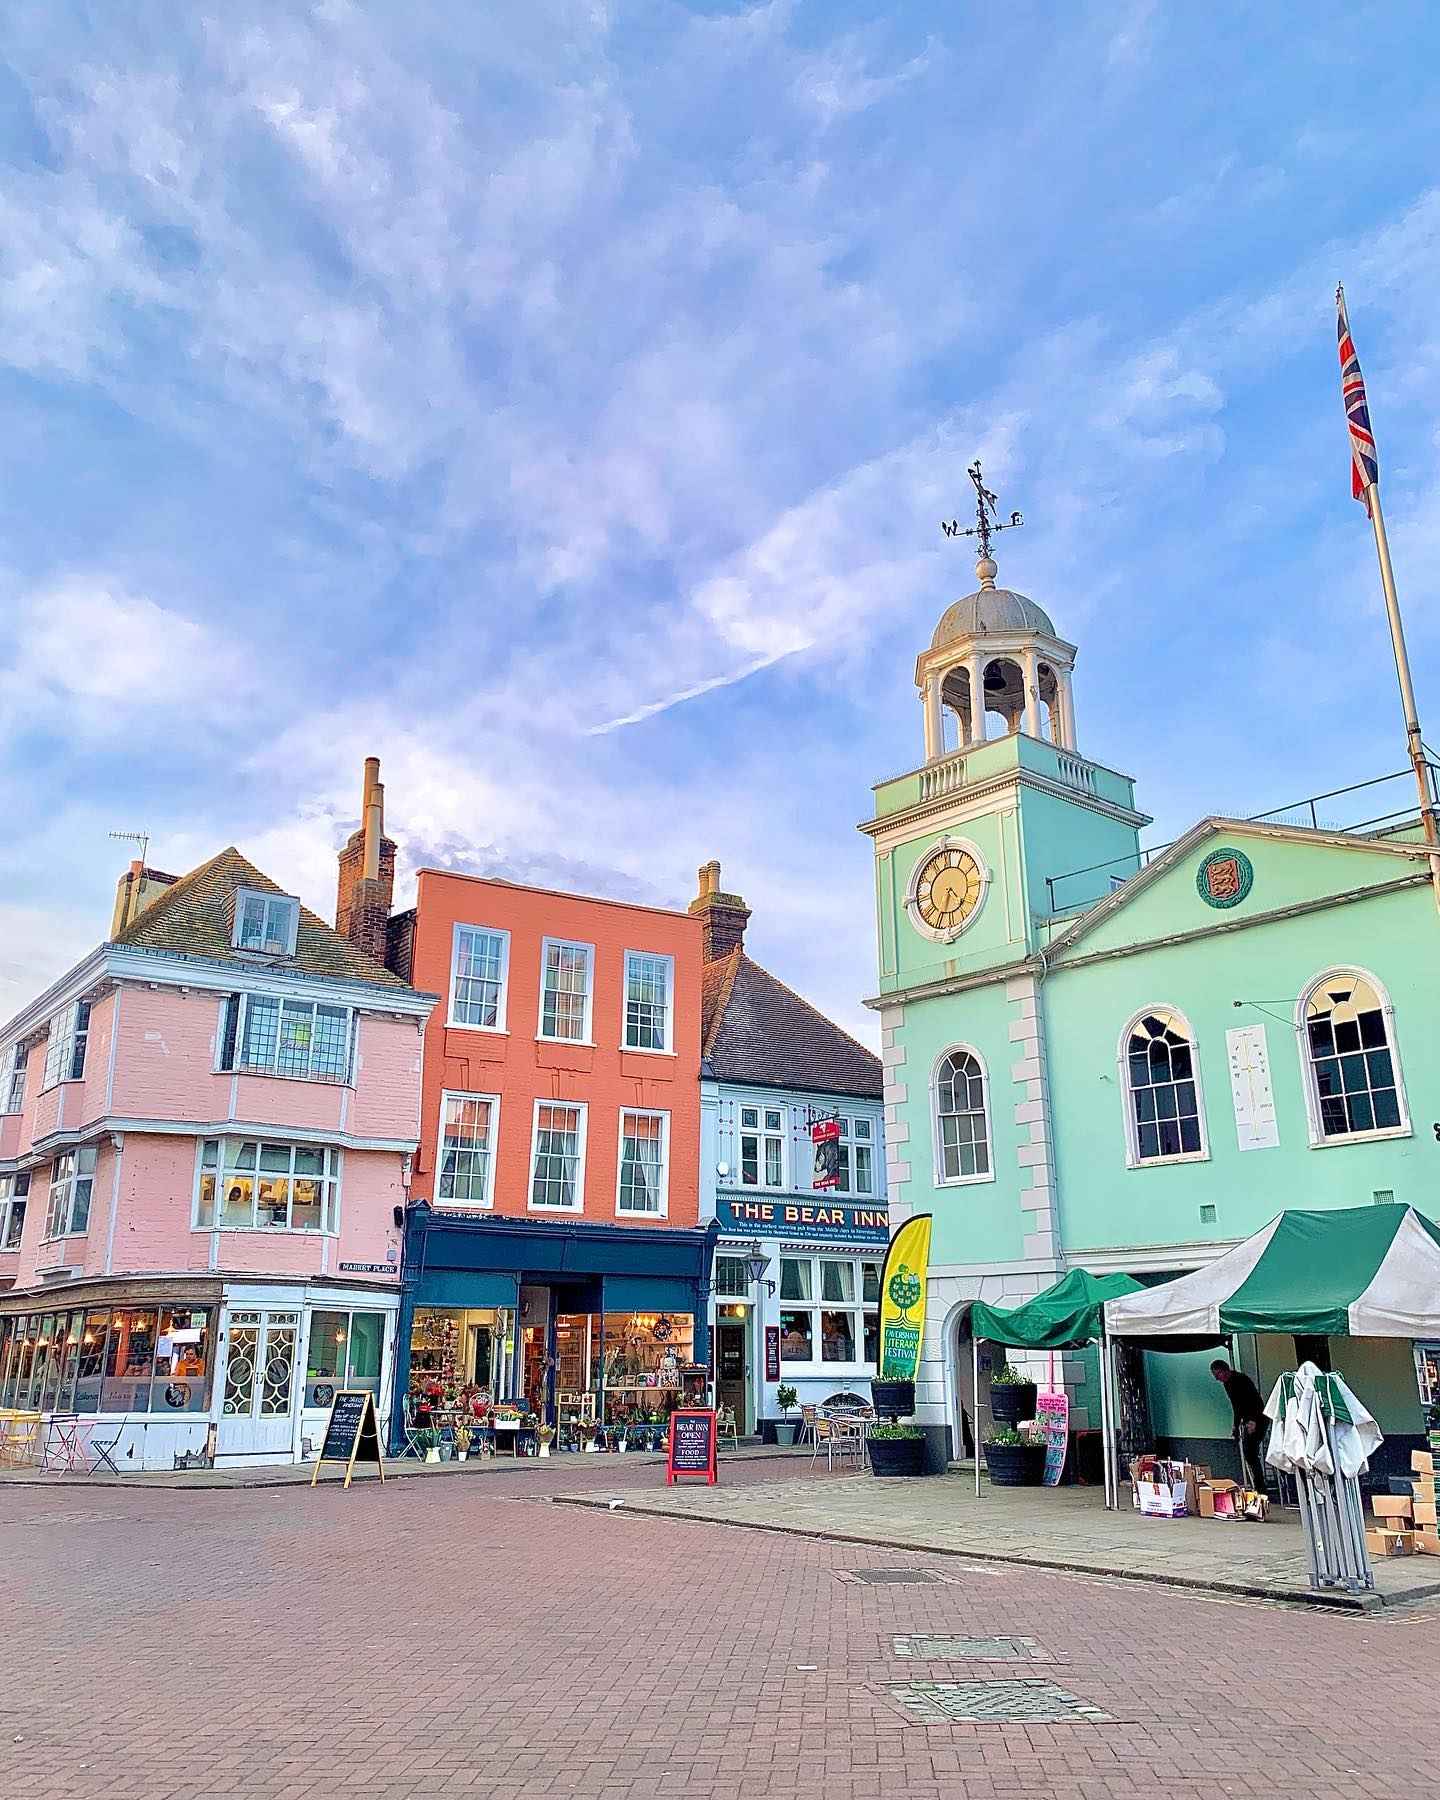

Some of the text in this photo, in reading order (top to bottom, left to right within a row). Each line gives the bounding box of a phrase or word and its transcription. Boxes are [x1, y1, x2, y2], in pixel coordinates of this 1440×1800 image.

[730, 1202, 889, 1228] THE BEAR INN
[373, 1265, 394, 1273] PLACE
[886, 1330, 918, 1339] FAVERSHAM
[886, 1338, 918, 1349] LITERARY
[885, 1347, 917, 1359] FESTIVAL
[676, 1423, 709, 1431] BEAR INN
